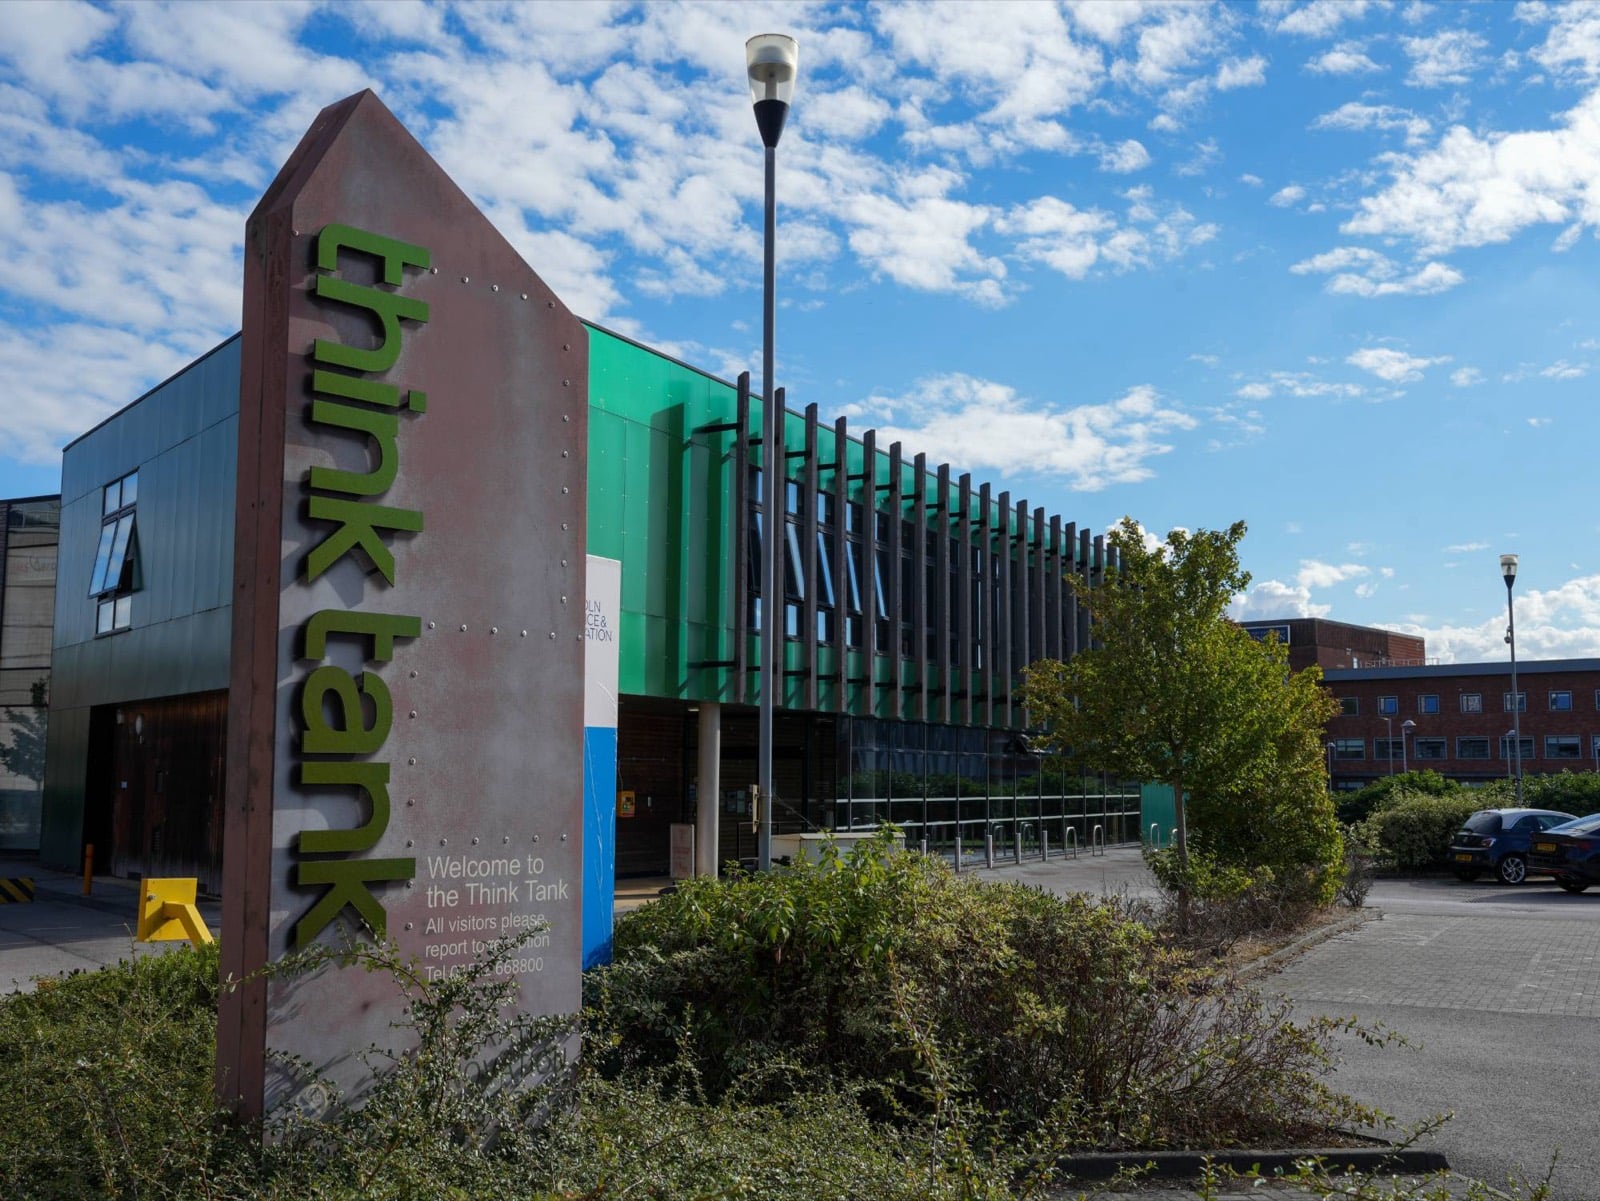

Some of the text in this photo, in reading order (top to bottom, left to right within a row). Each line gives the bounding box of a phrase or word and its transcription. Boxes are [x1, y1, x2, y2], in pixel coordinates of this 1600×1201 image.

[297, 223, 430, 950] think tank
[427, 853, 544, 879] Welcome to
[426, 879, 569, 908] the Think Tank
[425, 912, 545, 934] All visitors please
[425, 939, 468, 960] report
[472, 938, 485, 953] to
[495, 957, 544, 975] 668800
